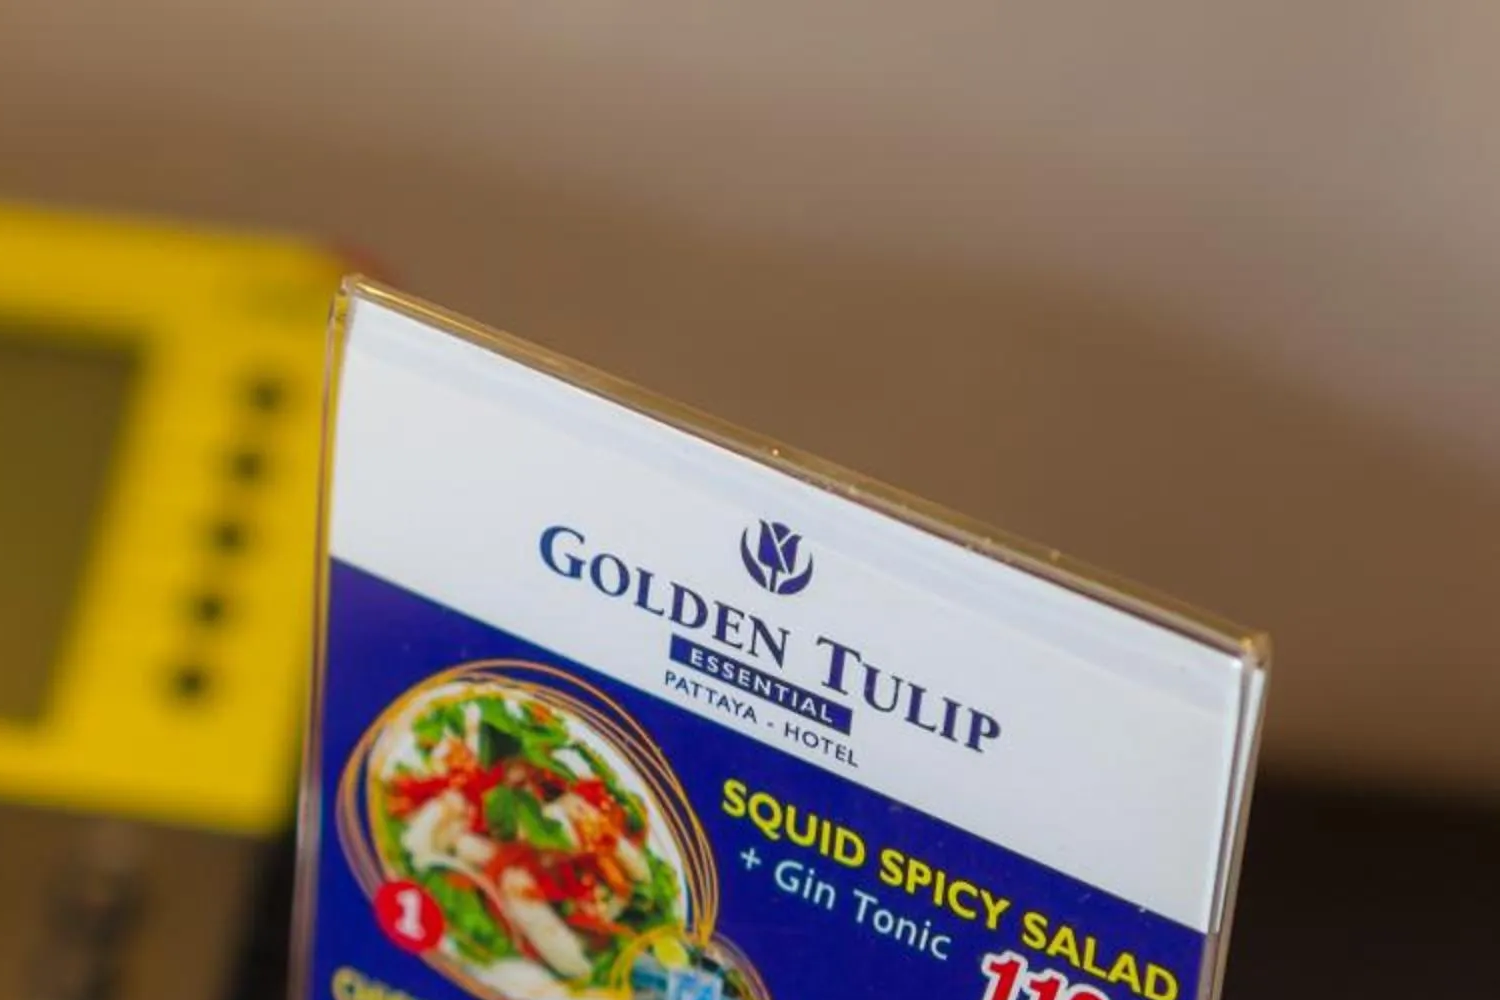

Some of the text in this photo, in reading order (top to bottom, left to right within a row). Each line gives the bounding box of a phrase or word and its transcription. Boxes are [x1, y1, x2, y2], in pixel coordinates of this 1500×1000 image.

[539, 525, 1003, 755] GOLDEN TULIP
[690, 647, 833, 724] ESSENTIAL
[665, 670, 757, 725] PATTAYA
[784, 721, 858, 767] HOTEL
[722, 778, 866, 868] SQUID
[879, 849, 1011, 931] SPICY
[394, 890, 426, 940] 1
[774, 859, 837, 910] Gin
[853, 889, 952, 961] Tonic
